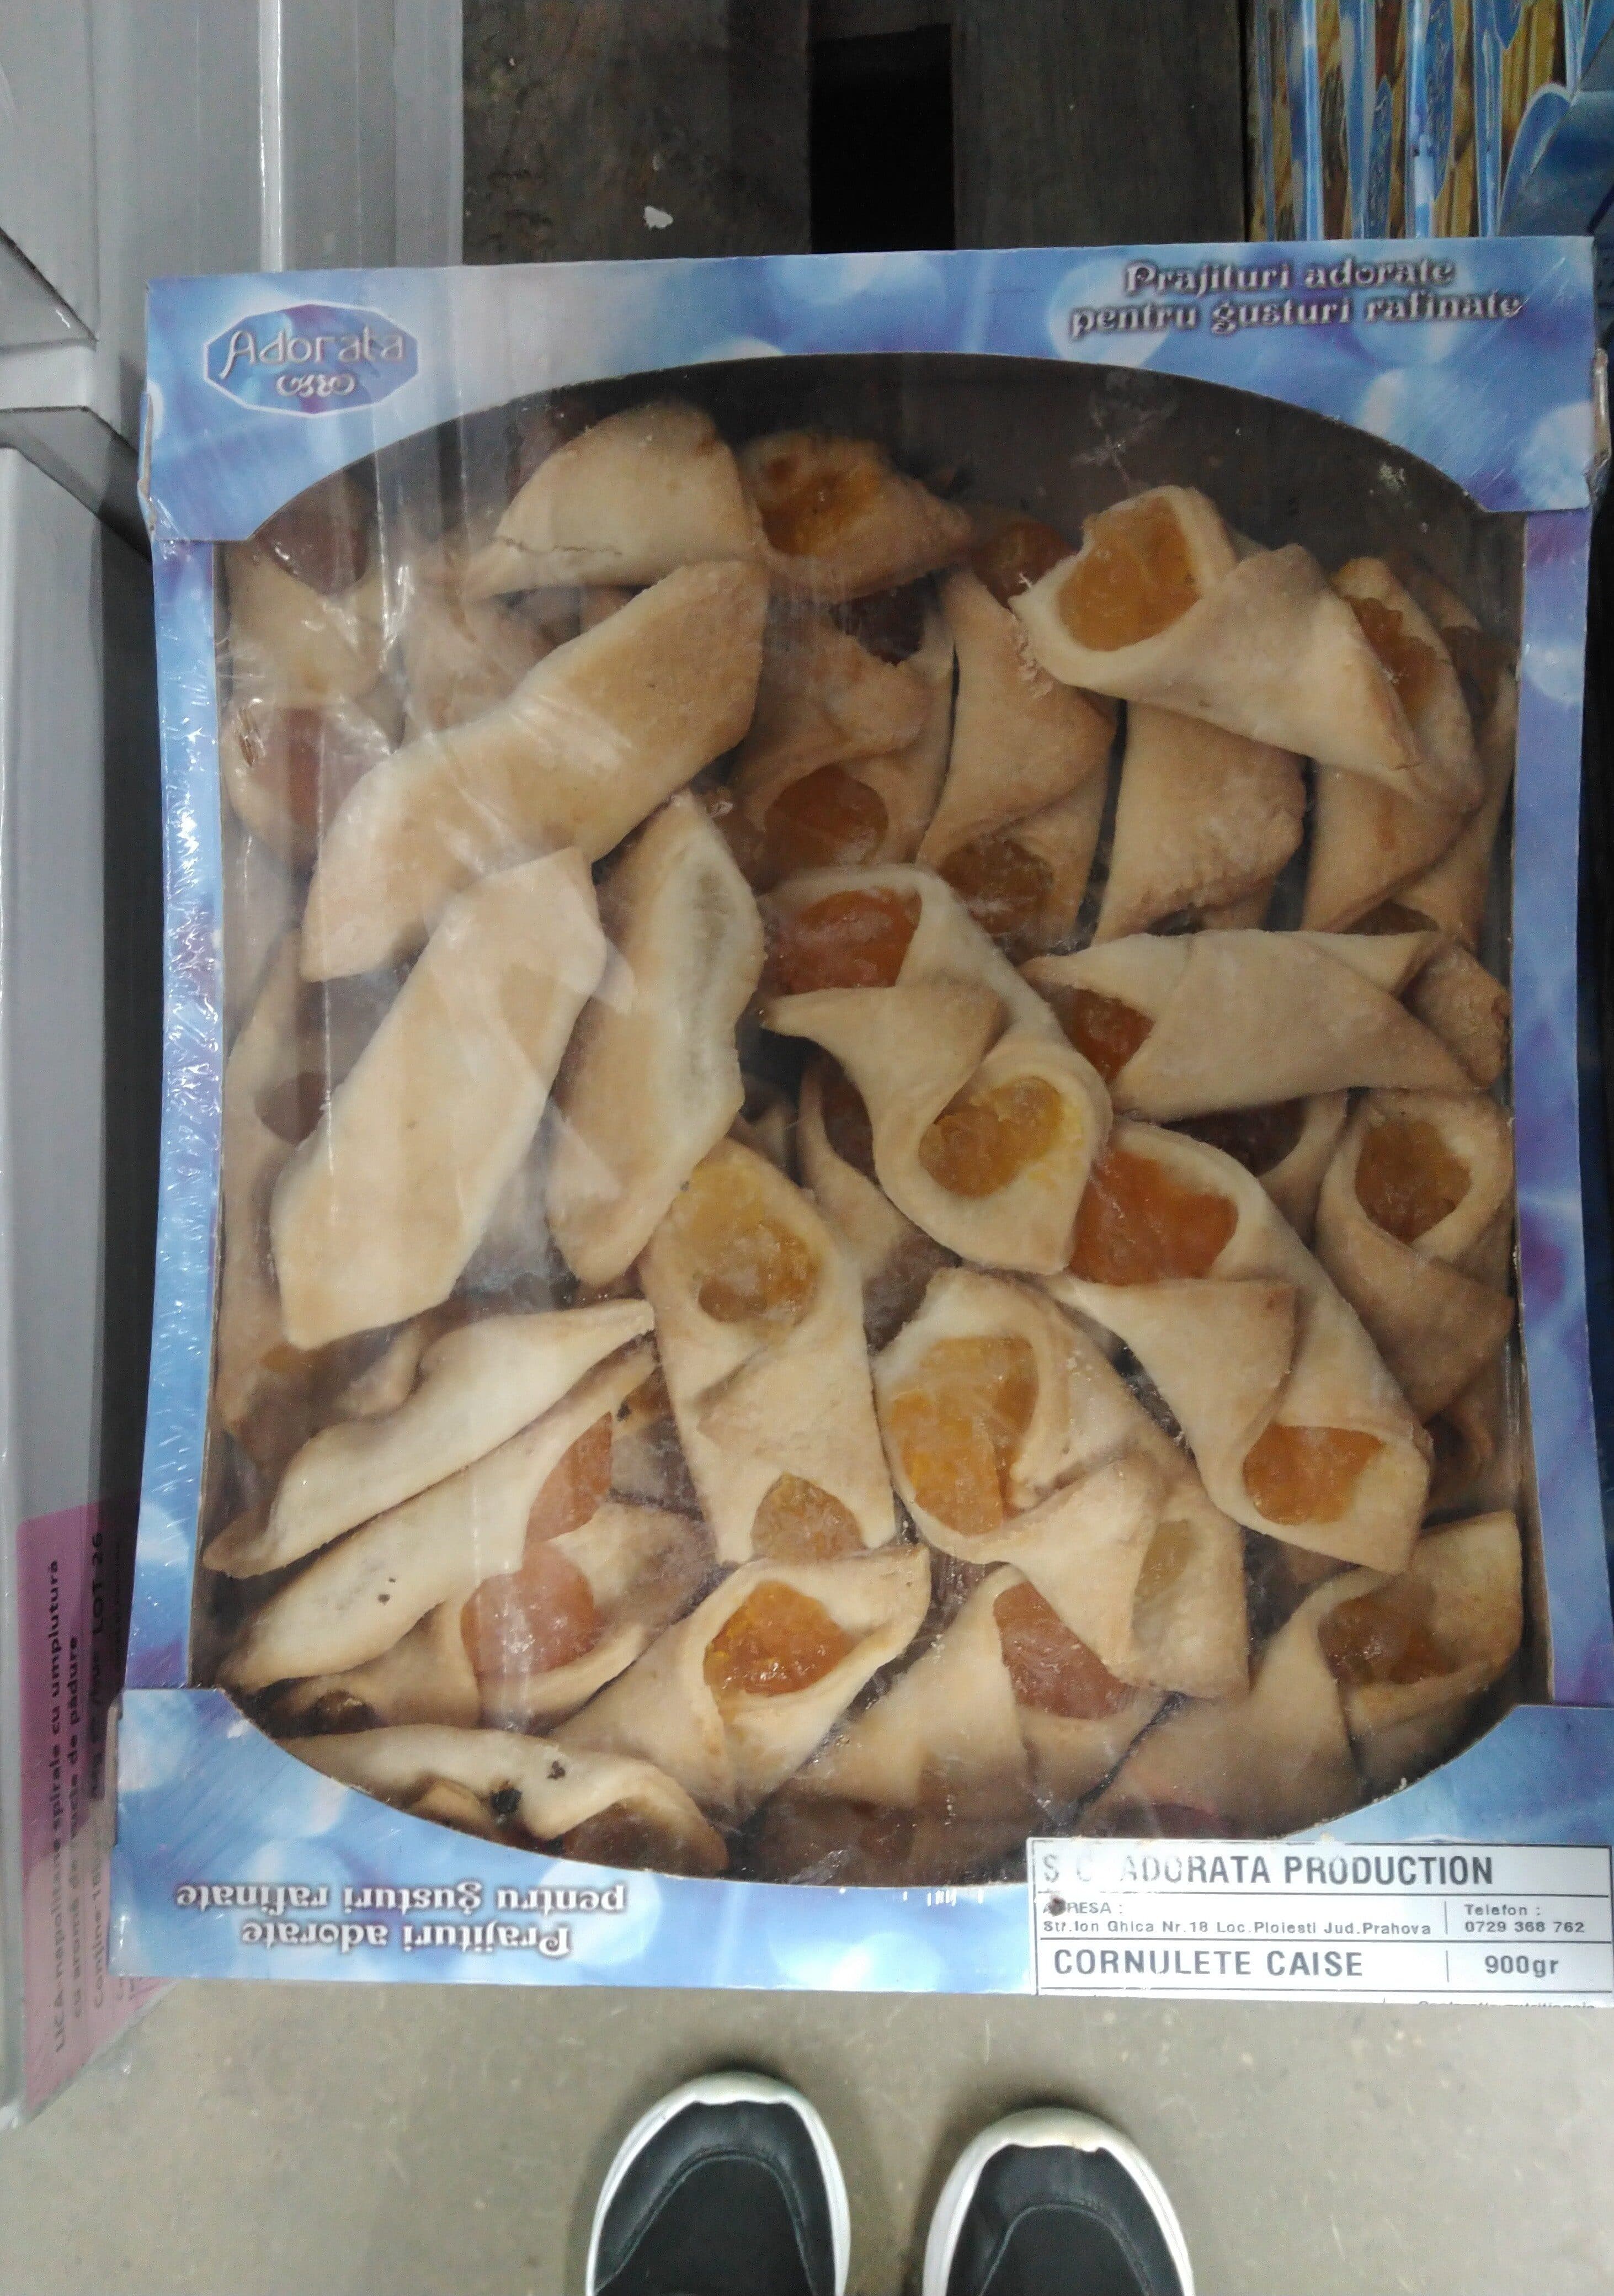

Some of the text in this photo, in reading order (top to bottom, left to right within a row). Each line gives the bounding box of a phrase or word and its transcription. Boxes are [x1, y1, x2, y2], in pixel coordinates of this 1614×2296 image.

[1126, 257, 1455, 298] Prajituri adorate
[1072, 289, 1523, 338] pentru gusturi rafinate
[220, 324, 405, 380] Adorata
[92, 1580, 104, 1635] LOT
[51, 1707, 60, 1735] cu
[1120, 1854, 1271, 1884] ADORATA
[1285, 1856, 1494, 1885] PRODUCTION
[177, 1881, 625, 1917] pentru gusturi rafinate
[1043, 1901, 1111, 1914] ARESA
[1464, 1904, 1528, 1916] Telefon
[242, 1921, 569, 1957] Prajituri adorate
[1107, 1921, 1154, 1933] Ghica
[1162, 1921, 1208, 1933] Nr.18
[1217, 1922, 1317, 1934] Loc.Ploiesti
[1324, 1922, 1431, 1935] Jud.Prahova
[1465, 1921, 1507, 1933] 0729
[1553, 1922, 1585, 1933] 762
[1054, 1948, 1363, 1977] CORNULETE CAISE
[1484, 1955, 1559, 1978] 900gr
